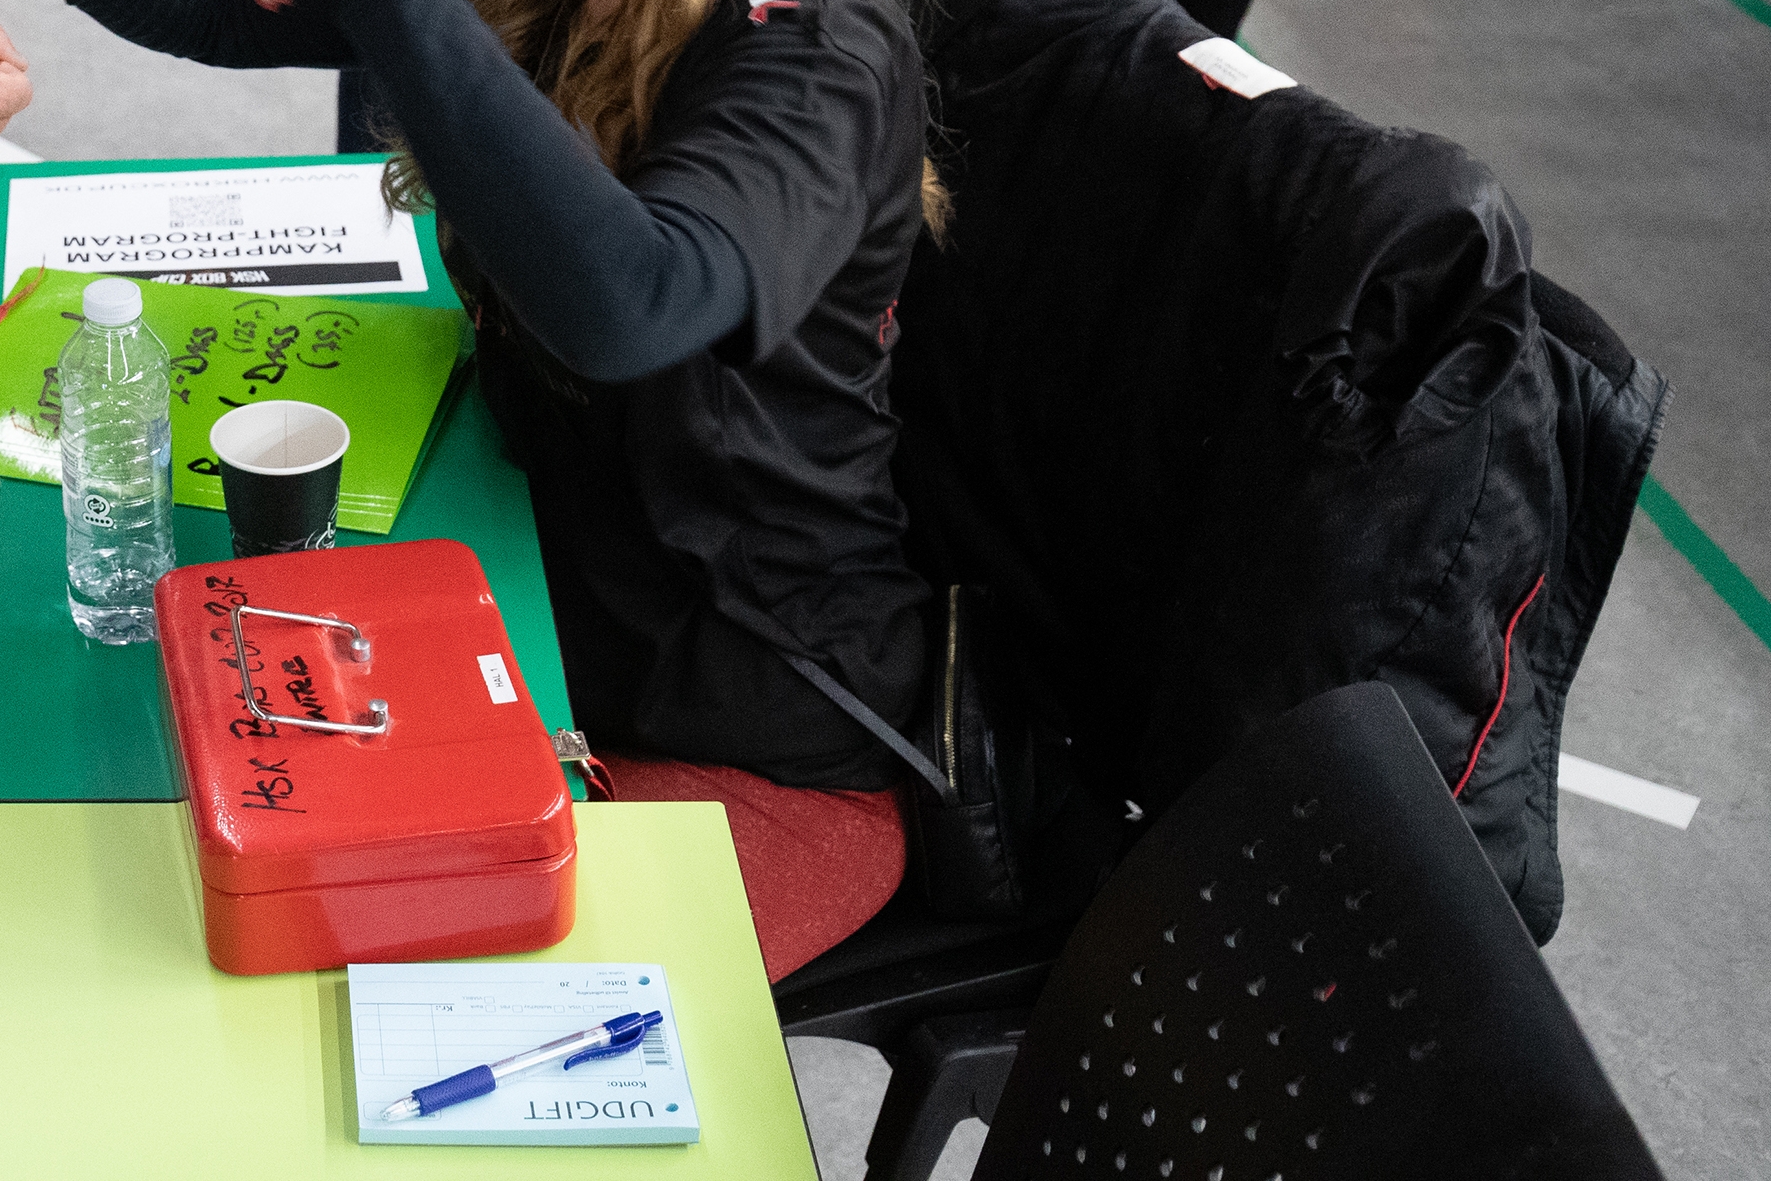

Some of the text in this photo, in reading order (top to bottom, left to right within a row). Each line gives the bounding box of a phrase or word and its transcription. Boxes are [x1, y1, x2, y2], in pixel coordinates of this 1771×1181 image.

[64, 226, 347, 247] FIGHT-PROGRAM
[68, 242, 342, 263] KAMPPROGRAM
[191, 271, 228, 283] BOX
[231, 270, 270, 283] HSK
[492, 674, 504, 688] HAL
[241, 758, 307, 814] HSK
[607, 1080, 647, 1088] Konto:
[524, 1100, 654, 1120] UDGIFT
